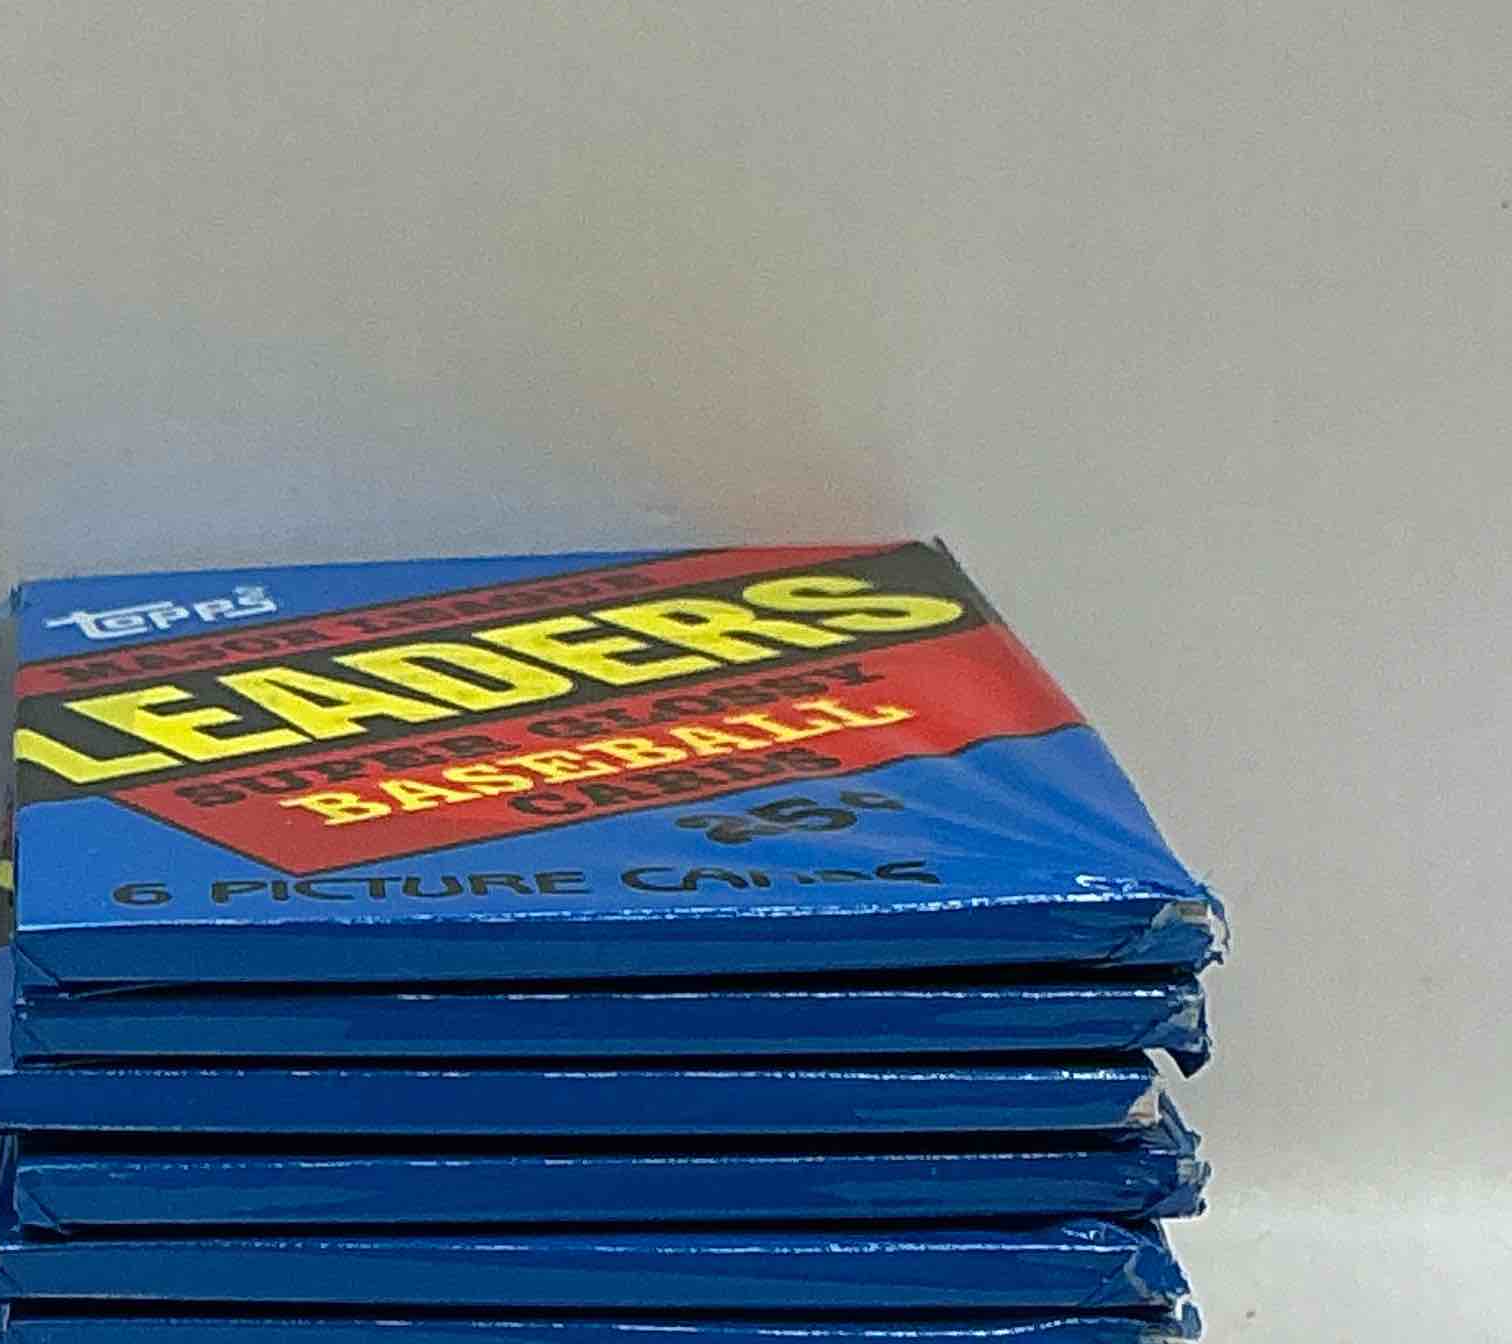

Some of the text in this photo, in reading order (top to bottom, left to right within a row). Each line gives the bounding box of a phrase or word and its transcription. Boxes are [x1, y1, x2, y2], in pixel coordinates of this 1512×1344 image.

[15, 574, 965, 785] LEADERS
[61, 626, 328, 681] MAJOR
[172, 661, 885, 809] SUPER GLOSSY
[279, 698, 913, 827] BASEBALL
[506, 748, 843, 820] CARDS
[112, 881, 174, 907] 6
[210, 869, 598, 905] PICTURE
